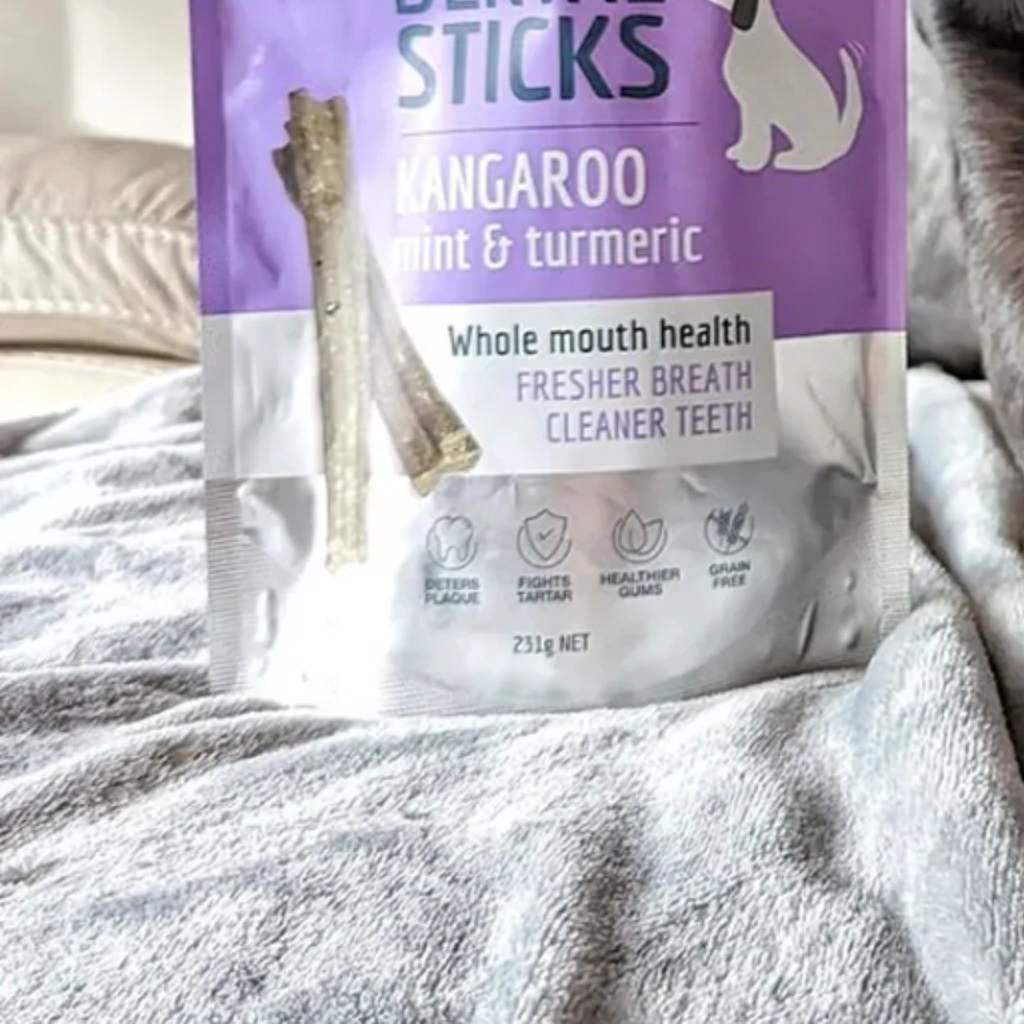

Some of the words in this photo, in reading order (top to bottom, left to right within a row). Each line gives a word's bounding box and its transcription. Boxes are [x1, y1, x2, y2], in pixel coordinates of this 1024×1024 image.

[398, 14, 670, 108] STICKS
[396, 147, 646, 213] KANGAROO
[393, 227, 470, 272] mint
[483, 224, 513, 269] &
[525, 216, 703, 268] turmeric
[448, 323, 538, 356] Whole
[549, 320, 648, 354] mouth
[660, 314, 752, 349] health
[517, 366, 641, 402] FRESHER
[653, 360, 753, 397] BREATH
[547, 407, 666, 443] CLEANER
[676, 401, 753, 437] TEETH
[600, 568, 681, 585] HEALTHIER
[709, 560, 751, 576] GRAIN
[425, 577, 480, 590] DETERS
[517, 575, 572, 589] FIGHTS
[713, 574, 747, 589] FREE
[425, 591, 480, 605] PLAQUE
[517, 589, 573, 604] TARTAR
[618, 583, 663, 598] GUMS
[513, 635, 555, 658] 231g
[559, 633, 591, 652] NET
